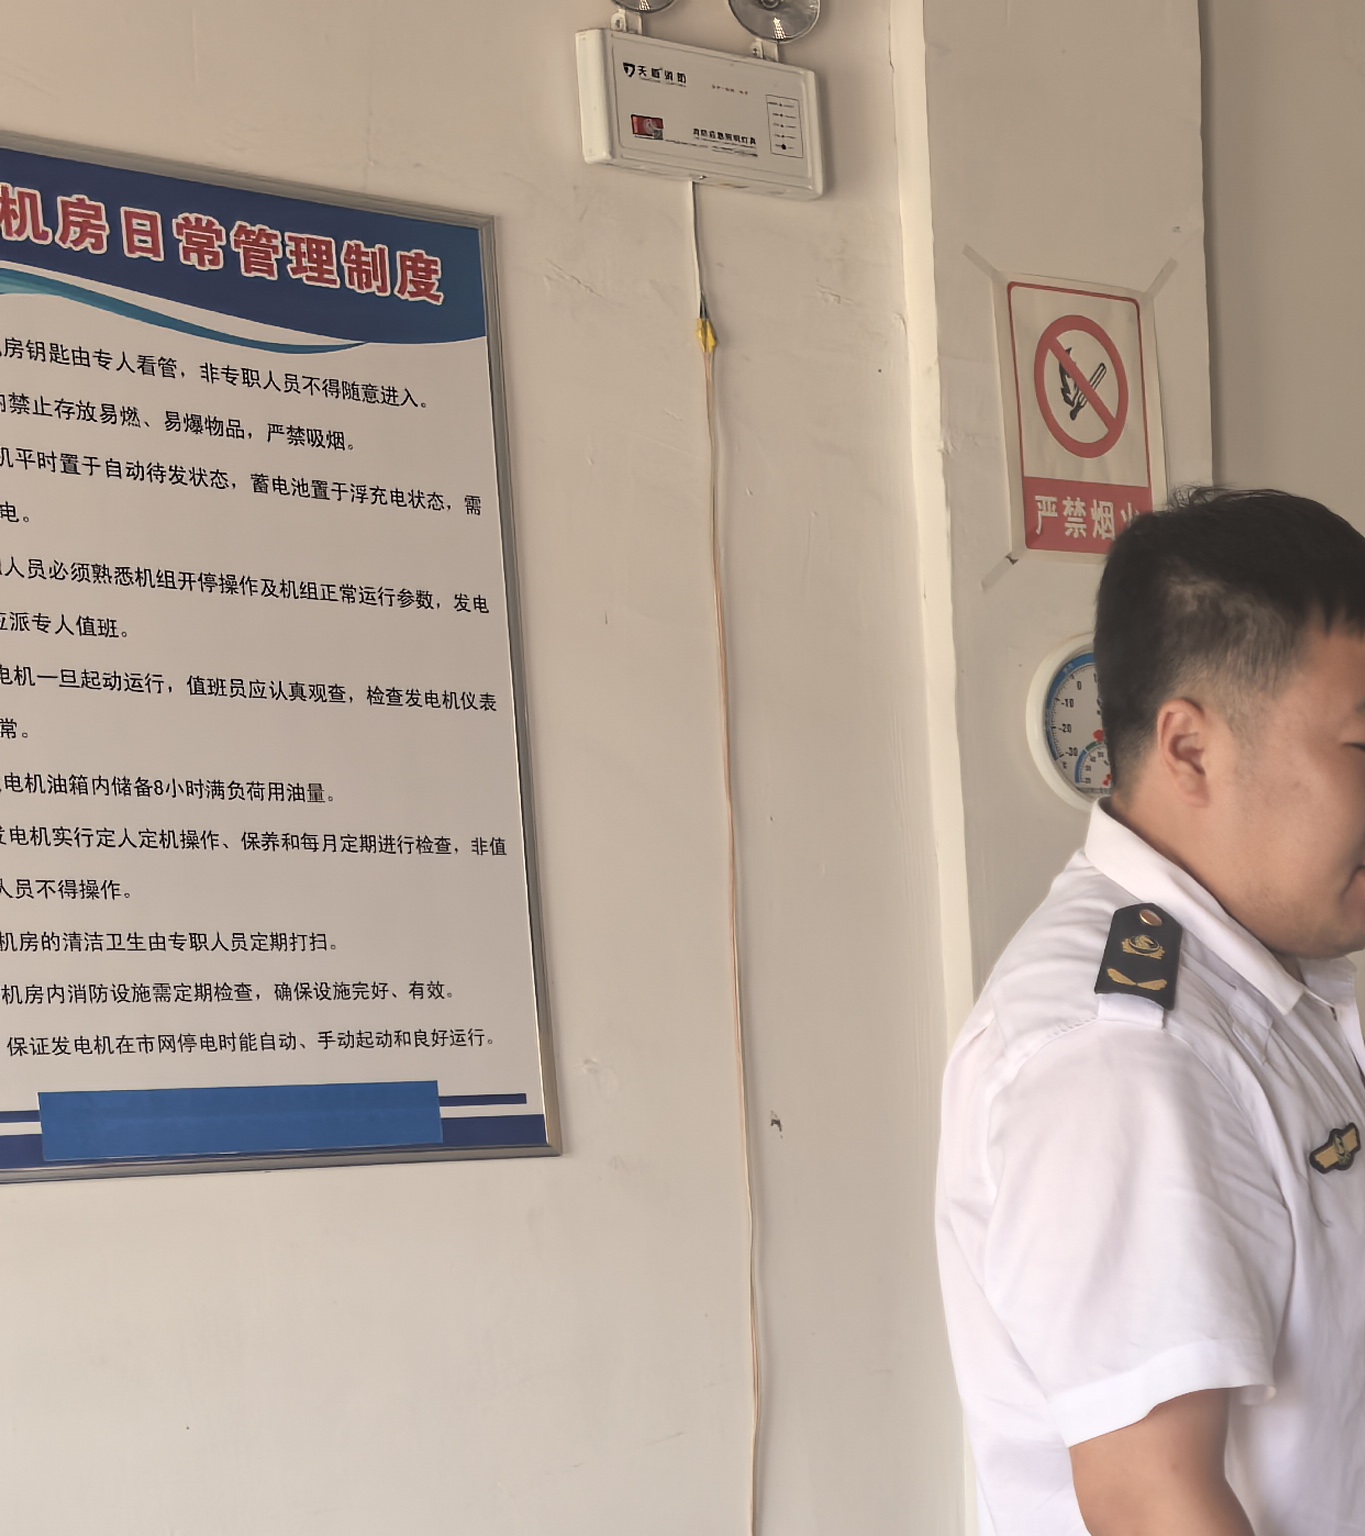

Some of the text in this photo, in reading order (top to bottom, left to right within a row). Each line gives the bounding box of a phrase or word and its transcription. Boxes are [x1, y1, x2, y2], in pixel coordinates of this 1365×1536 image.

[0, 183, 444, 304] 机房日常管理制度
[0, 337, 427, 409] 房钥匙由专人看管，非专职人员不得随意进入。
[0, 556, 490, 613] 人员必须熟悉机组开停操作及机组正常运行参数，发电
[0, 772, 334, 803] 电机油箱内储备8小时满负荷用油量。
